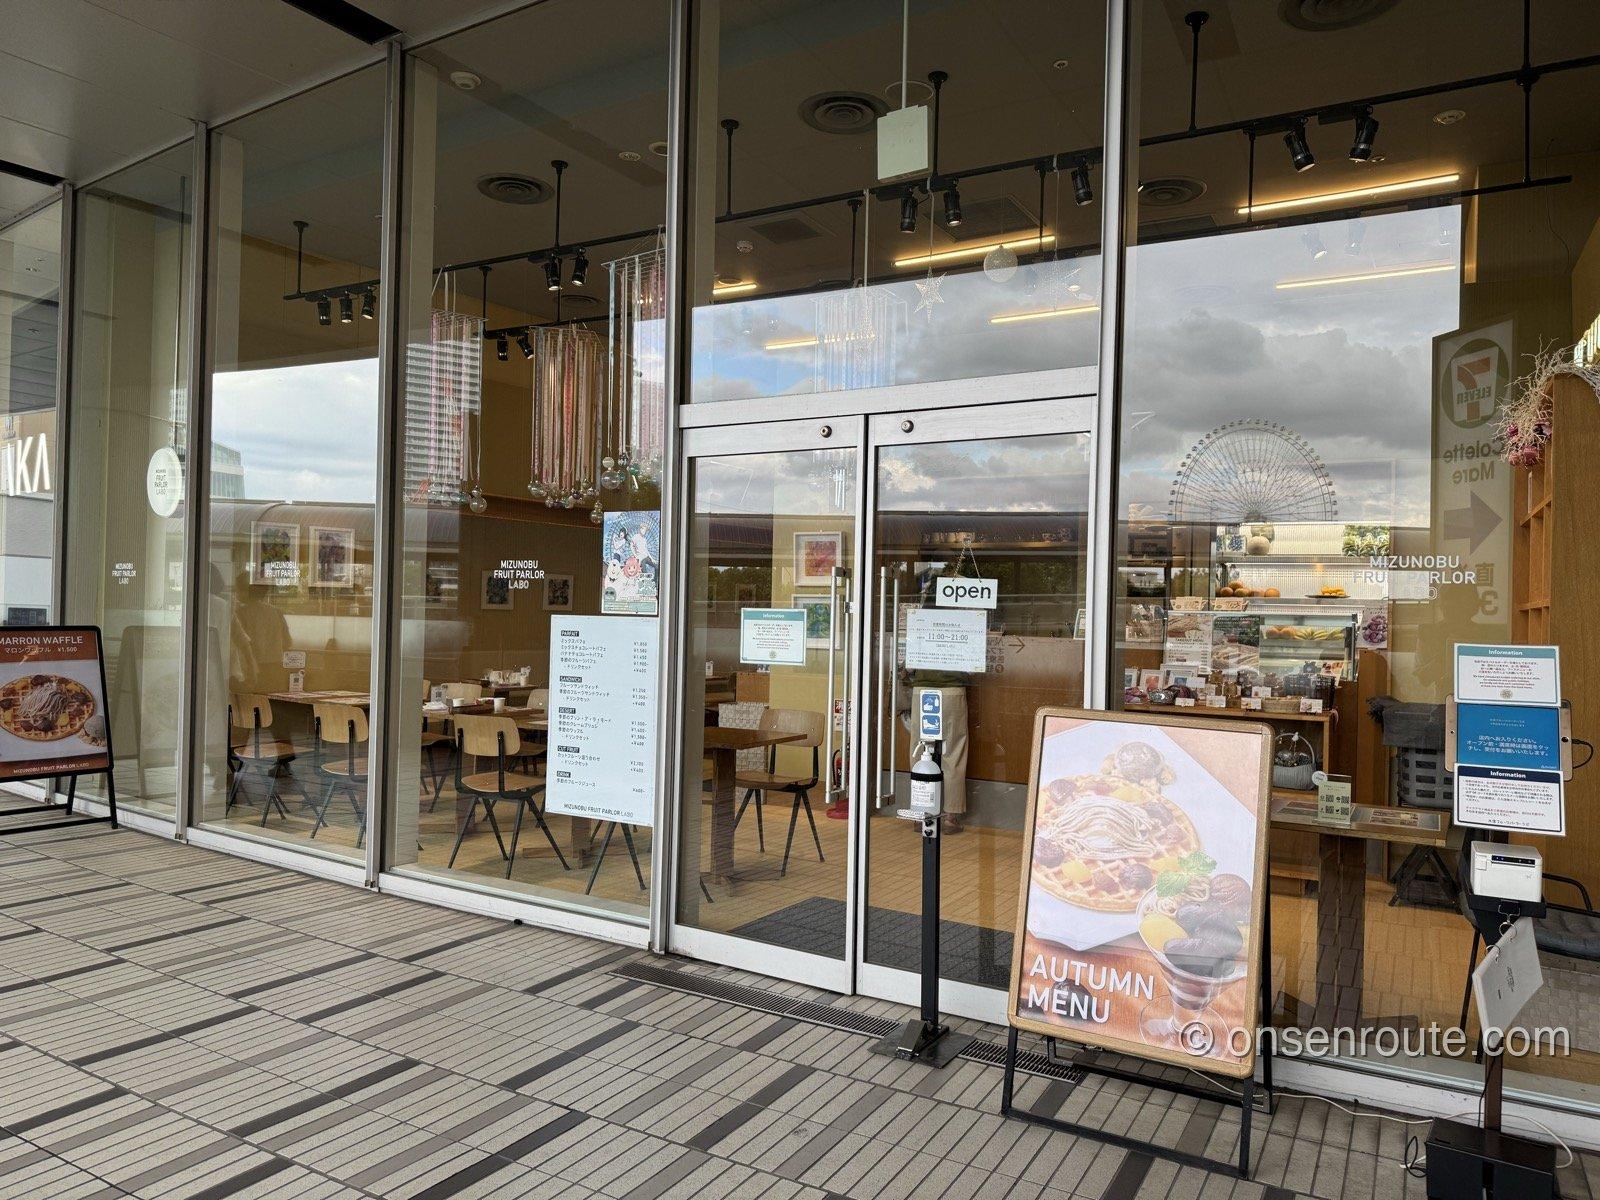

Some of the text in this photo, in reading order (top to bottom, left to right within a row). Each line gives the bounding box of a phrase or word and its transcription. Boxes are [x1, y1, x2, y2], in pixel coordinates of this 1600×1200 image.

[500, 560, 538, 569] MIZUNOBU
[1370, 556, 1460, 568] MIZUNOBU
[494, 570, 545, 579] FRUIT PARLOR
[508, 580, 529, 589] LABO
[942, 585, 991, 602] open
[0, 636, 83, 645] MARRON WAFFLE
[1030, 954, 1154, 1000] AUTUMN
[1028, 984, 1110, 1023] MENU
